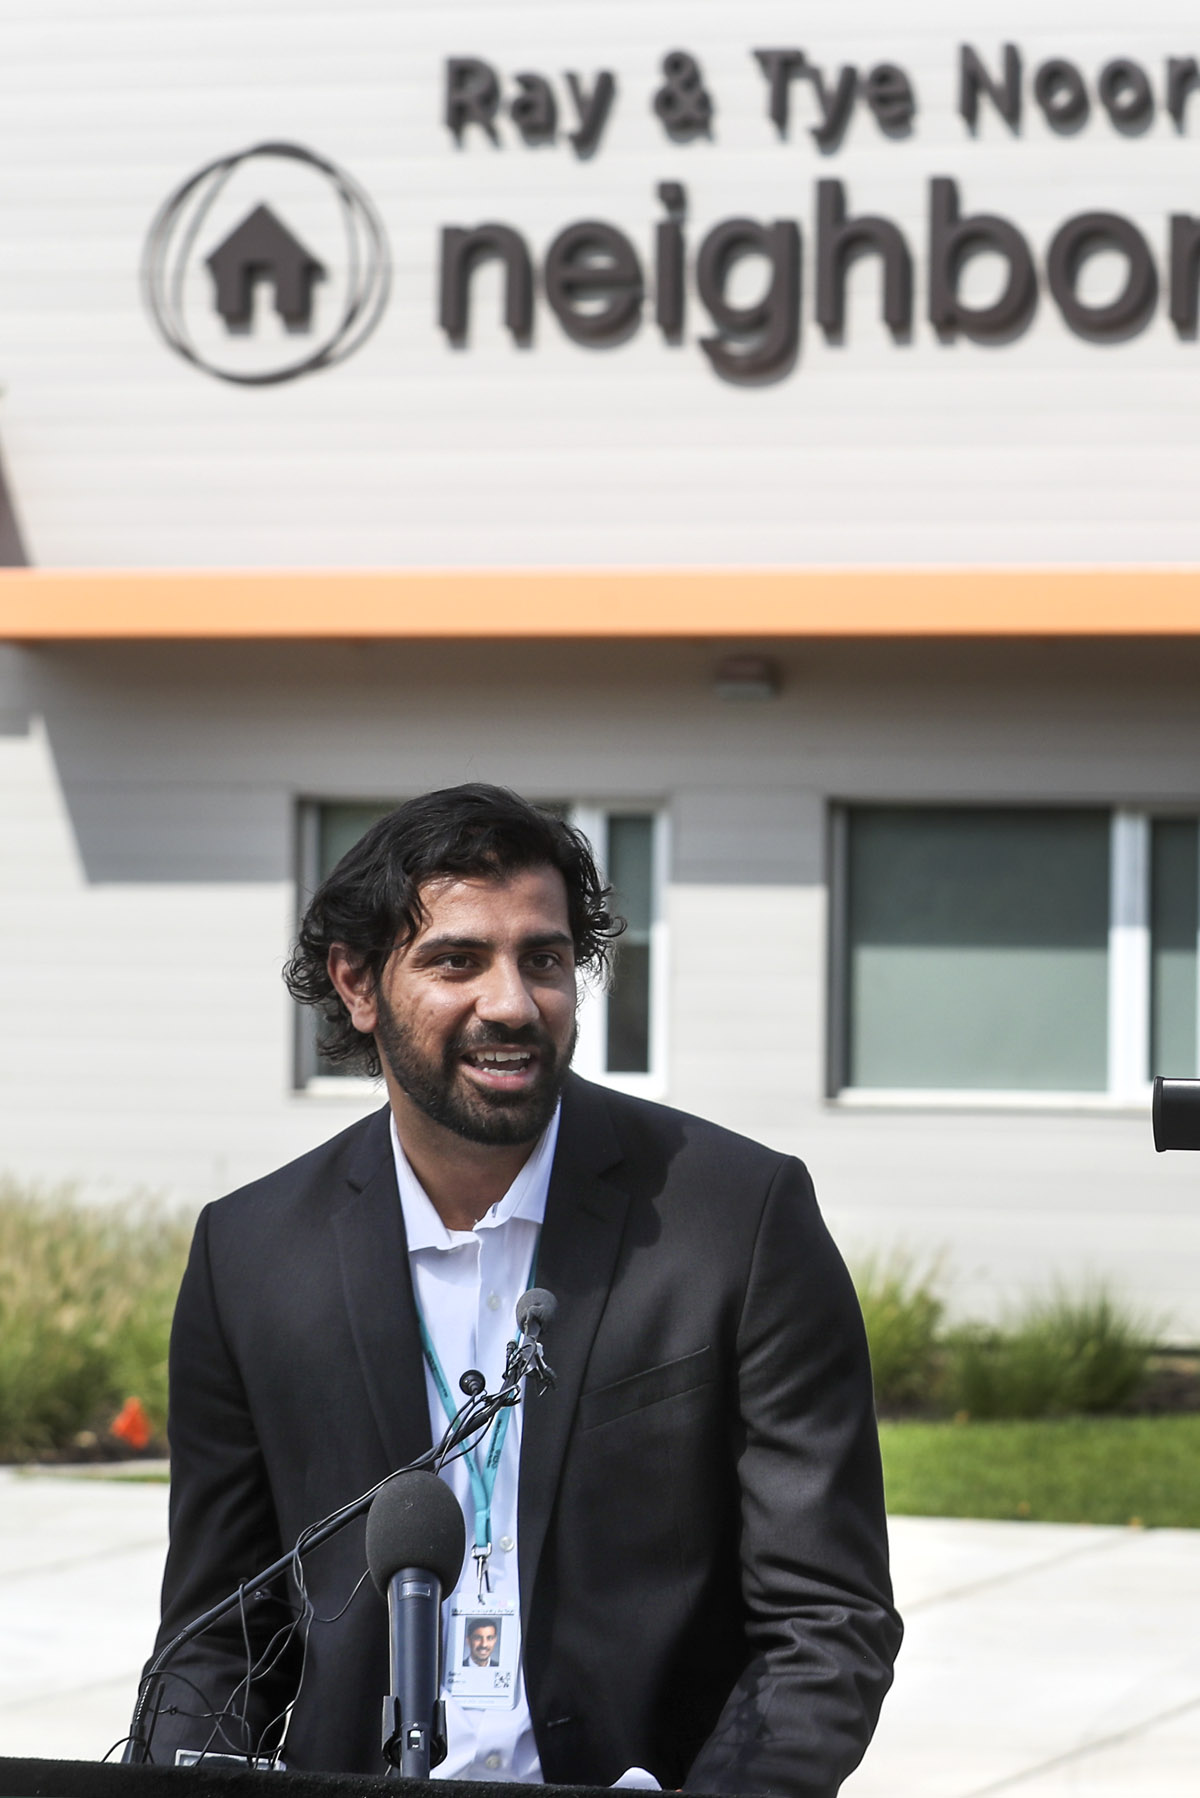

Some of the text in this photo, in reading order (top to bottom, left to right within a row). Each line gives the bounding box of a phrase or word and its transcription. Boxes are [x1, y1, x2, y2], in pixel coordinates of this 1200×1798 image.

[445, 57, 617, 161] Ray
[652, 51, 715, 143] &
[752, 49, 917, 155] Tye
